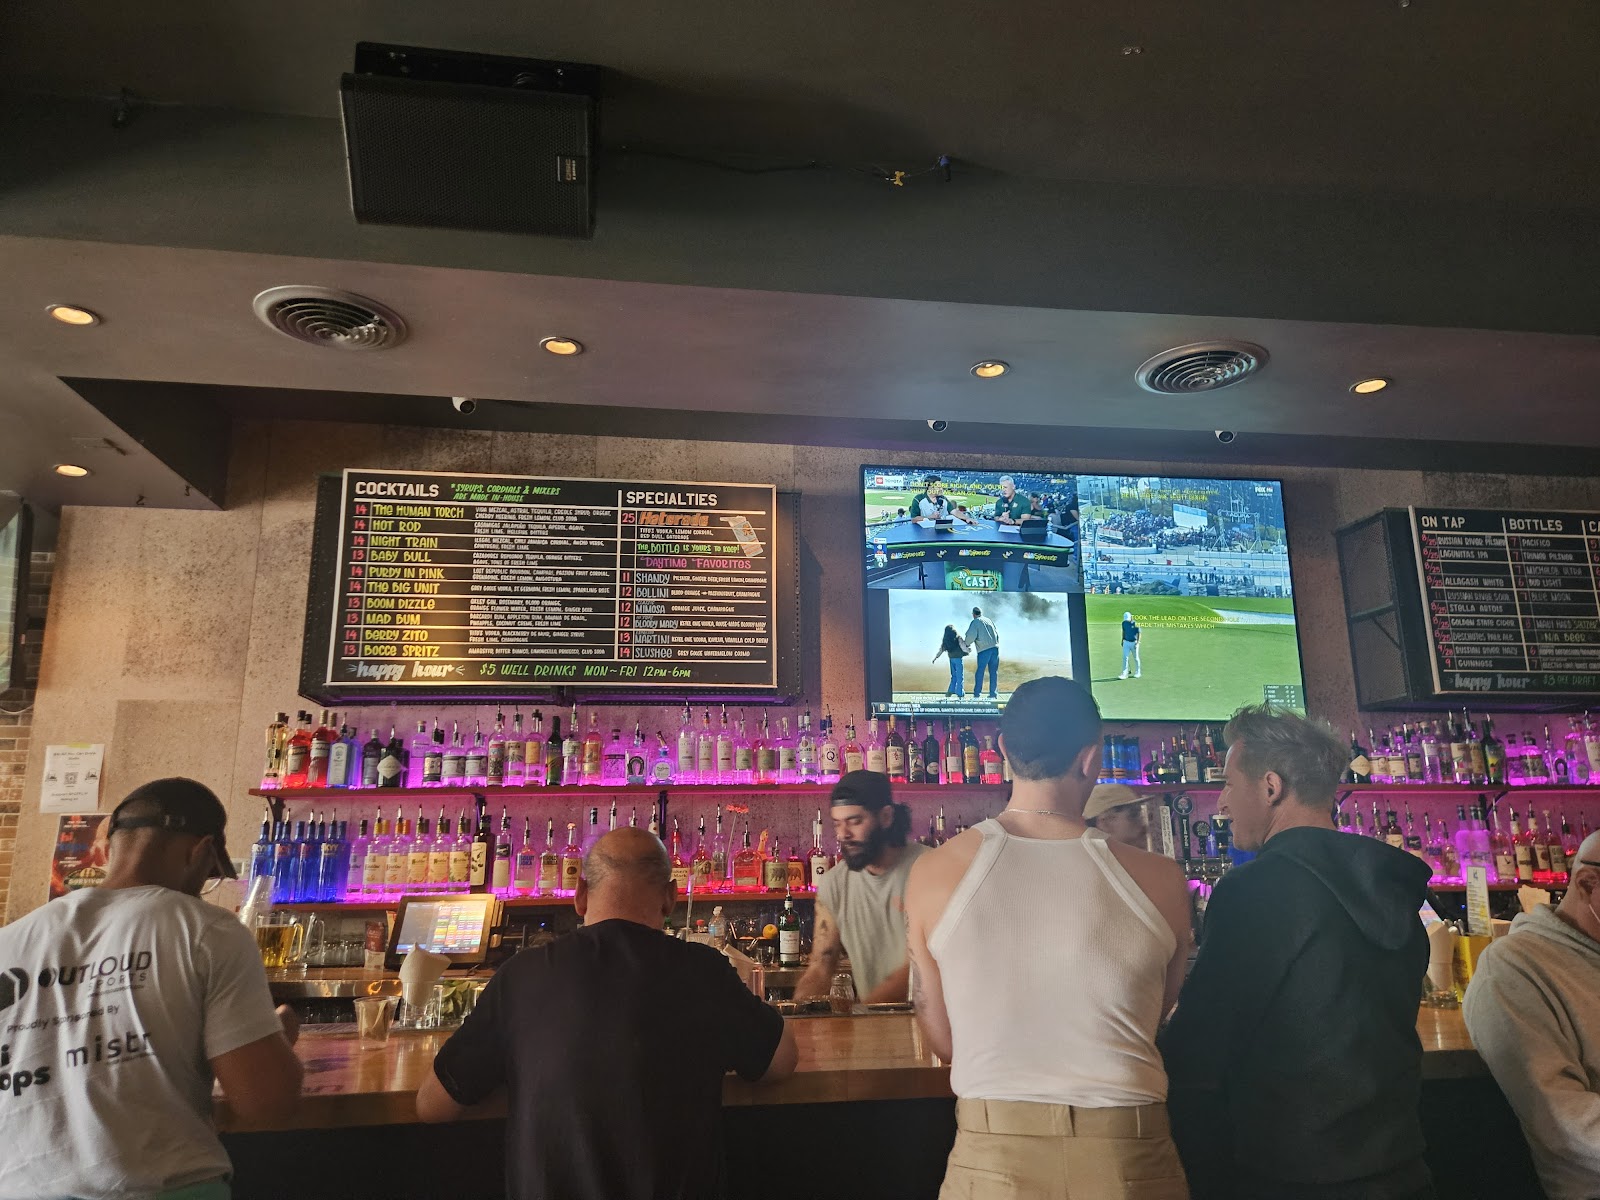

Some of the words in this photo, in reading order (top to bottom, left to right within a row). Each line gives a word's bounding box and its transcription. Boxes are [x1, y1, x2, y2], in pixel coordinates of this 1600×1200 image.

[355, 482, 439, 497] COCKTAILS
[486, 485, 521, 494] CORDIALS
[523, 486, 529, 494] &
[533, 487, 560, 496] MIXERS
[491, 494, 524, 502] IN-HOUSE
[626, 491, 718, 507] SPECIALTIES
[356, 505, 367, 515] 14
[396, 506, 430, 518] HUMAN
[434, 506, 464, 518] TORCH
[622, 512, 636, 523] 25
[638, 511, 710, 526] Haterade
[1421, 516, 1438, 528] ON
[1442, 516, 1465, 529] TAP
[355, 520, 366, 530] 14
[373, 520, 394, 531] HOT
[399, 521, 421, 532] ROD
[1509, 518, 1563, 531] BOTTLES
[354, 536, 365, 545] 14
[371, 536, 401, 548] NIGHT
[406, 536, 438, 549] TRAIN
[1438, 536, 1463, 546] RUSSIAN
[1511, 537, 1516, 546] 7
[1522, 538, 1550, 547] PACIFICO
[352, 550, 365, 560] 13
[371, 550, 399, 562] BABY
[404, 552, 431, 563] BULL
[1440, 549, 1475, 559] LAGUNITAS
[1514, 552, 1519, 561] 7
[351, 566, 362, 576] 14
[369, 567, 401, 579] PURDY
[404, 567, 414, 578] IN
[419, 568, 445, 579] PINK
[1516, 565, 1521, 574] 7
[1563, 566, 1582, 575] ULTRA
[623, 572, 630, 582] 11
[636, 573, 670, 584] SHANDY
[965, 575, 990, 588] CAST
[1445, 577, 1479, 586] ALLAGASH
[1518, 578, 1524, 586] 6
[350, 581, 361, 591] 14
[392, 582, 411, 593] BIG
[414, 582, 440, 594] UNIT
[1529, 579, 1541, 587] BUD
[1543, 579, 1562, 587] LIGHT
[622, 587, 631, 596] 12
[1448, 592, 1473, 600] RUSSIAN
[1520, 592, 1527, 601] 7
[348, 597, 360, 607] 13
[1551, 593, 1571, 601] MOON
[367, 598, 395, 609] BOOM
[621, 602, 631, 612] 12
[636, 604, 665, 614] MIMOSA
[347, 612, 359, 623] 13
[366, 613, 392, 624] MAD
[396, 614, 421, 626] BUM
[620, 617, 630, 627] 12
[635, 620, 658, 628] BLOODY
[660, 620, 679, 630] MARY
[346, 630, 357, 640] 14
[402, 630, 428, 641] ZITO
[620, 631, 631, 643] 13
[635, 634, 670, 645] MARTINI
[344, 645, 356, 655] 13
[402, 645, 440, 657] SPRITZ
[620, 647, 630, 657] 14
[1502, 647, 1517, 655] HAZY
[1445, 659, 1450, 667] 9
[356, 661, 406, 682] happy
[412, 661, 455, 679] hour
[480, 663, 496, 675] $5
[500, 664, 529, 676] WELL
[534, 664, 576, 676] DRINKS
[1454, 673, 1493, 690] happy
[1497, 674, 1530, 689] hour
[1543, 675, 1555, 685] $3
[1572, 676, 1596, 685] DRAFT
[38, 951, 152, 988] OUTLOUD
[88, 972, 147, 990] SPORTS
[7, 1017, 49, 1033] Proudly
[52, 1008, 104, 1025] Sponsored
[107, 1005, 120, 1016] By
[66, 1032, 152, 1067] mistr
[0, 1066, 50, 1096] ops
